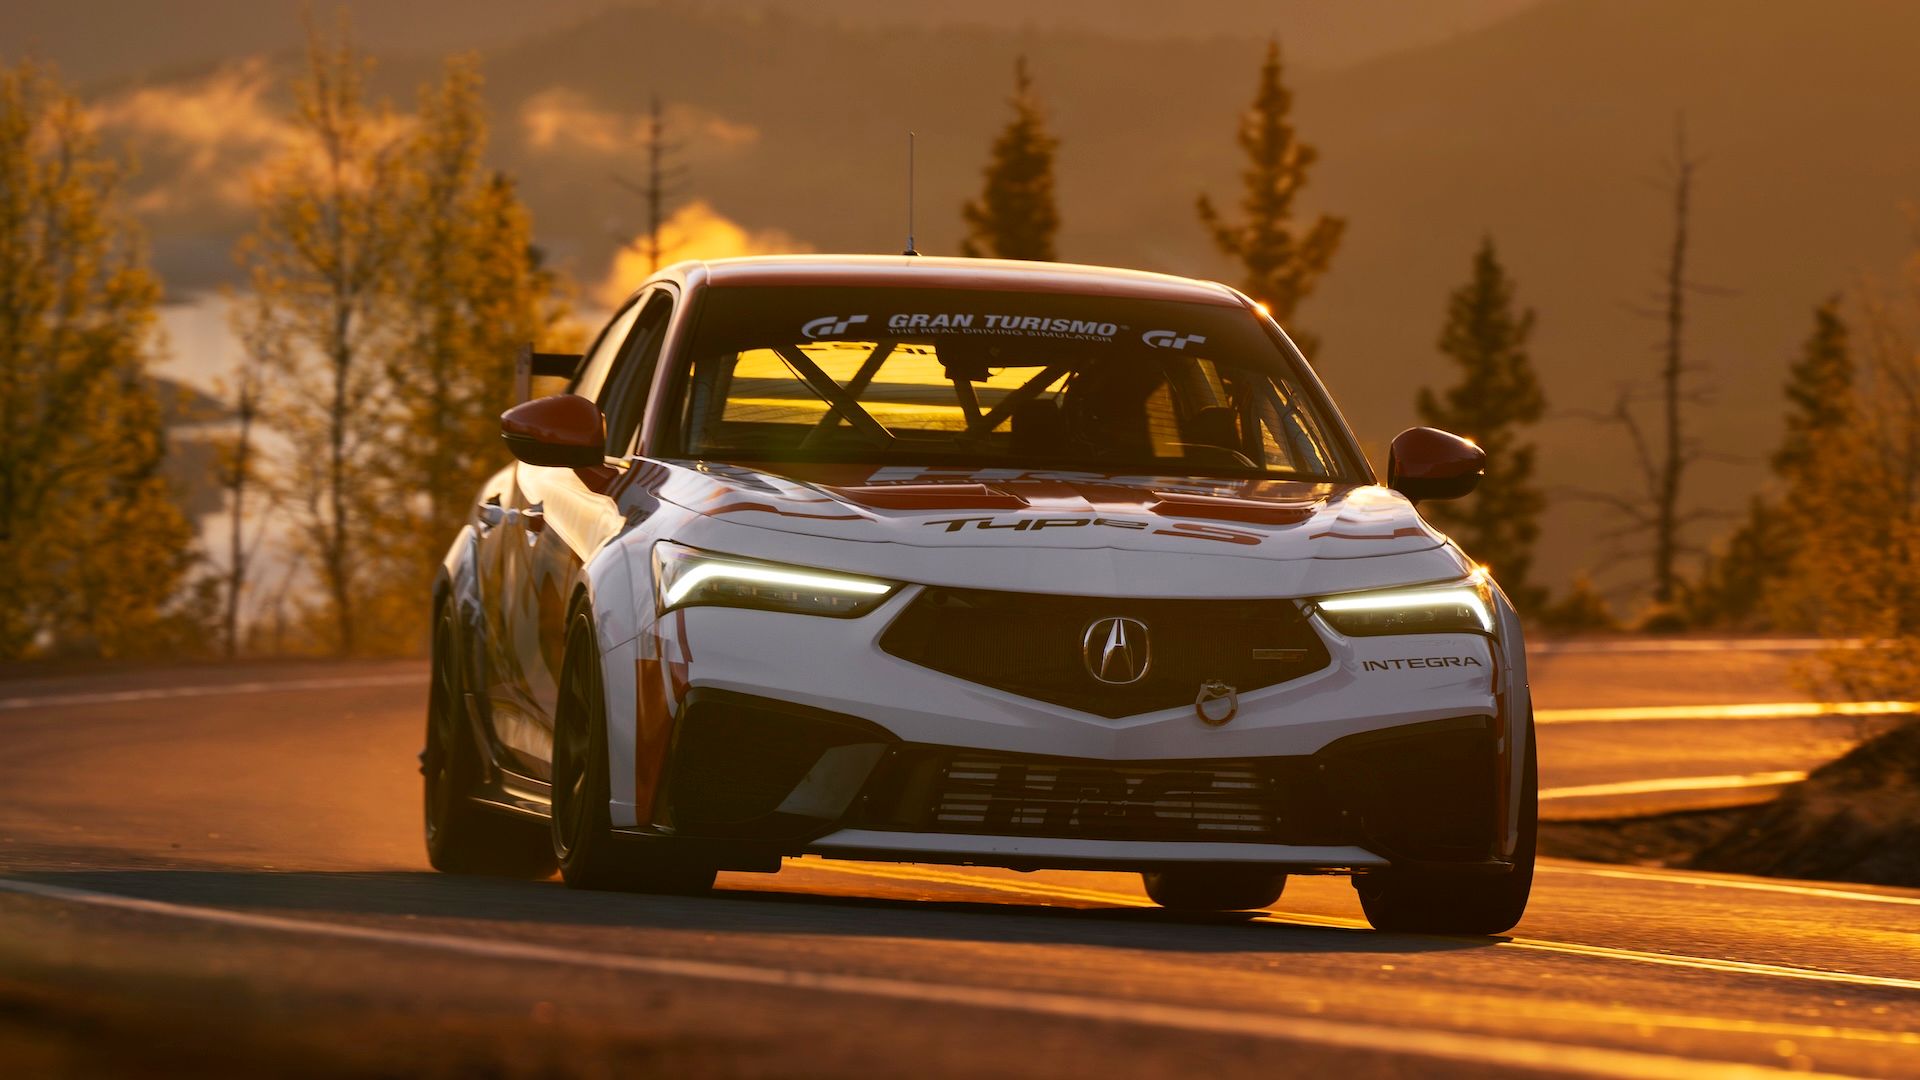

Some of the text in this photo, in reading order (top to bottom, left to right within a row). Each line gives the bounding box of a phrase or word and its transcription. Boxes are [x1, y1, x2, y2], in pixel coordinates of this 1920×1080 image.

[888, 314, 1119, 337] GRAN TURISMO
[963, 328, 1023, 336] DRIVING
[1026, 331, 1113, 343] SIMULATOR
[1152, 523, 1270, 546] S
[1362, 655, 1482, 672] INTEGRA
